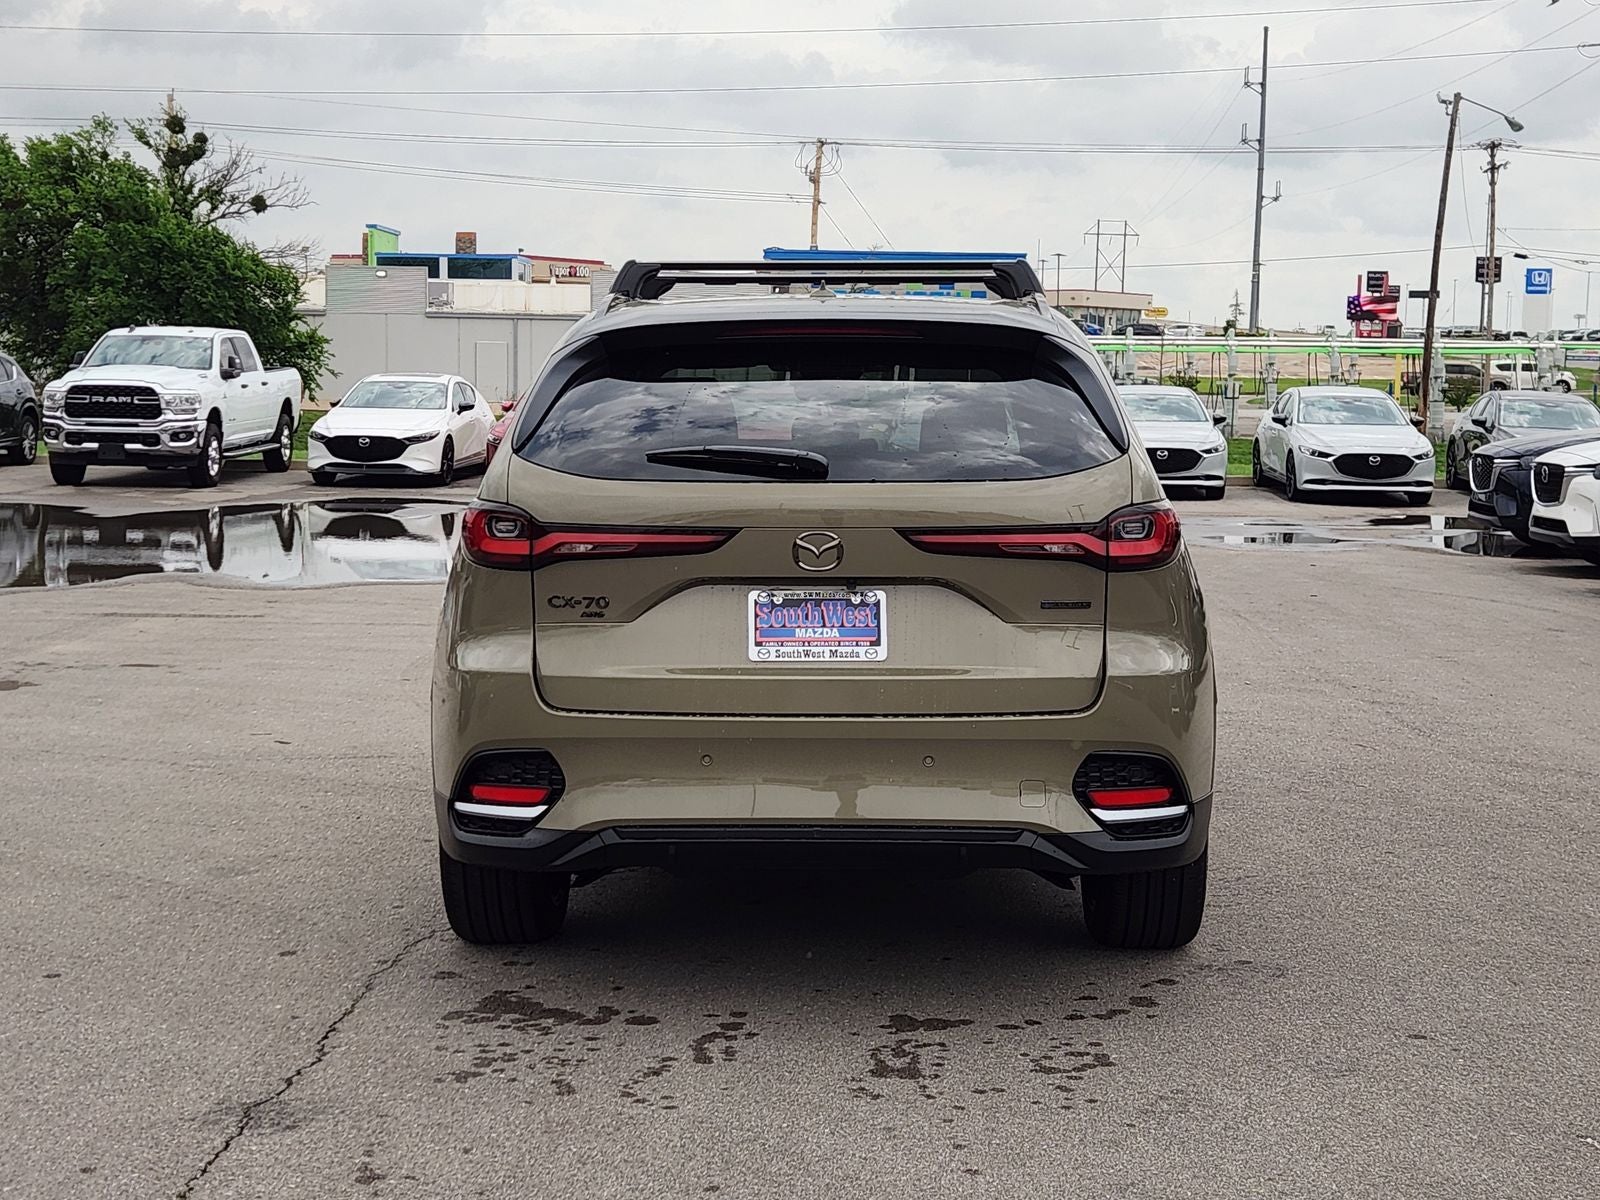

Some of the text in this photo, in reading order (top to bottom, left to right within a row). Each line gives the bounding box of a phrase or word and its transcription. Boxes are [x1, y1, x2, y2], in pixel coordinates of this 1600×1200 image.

[576, 266, 590, 277] 100
[547, 595, 610, 610] CX-70
[756, 600, 878, 628] SouthWest
[795, 628, 840, 638] MAZDA
[775, 648, 860, 659] SouthWest Mazda
